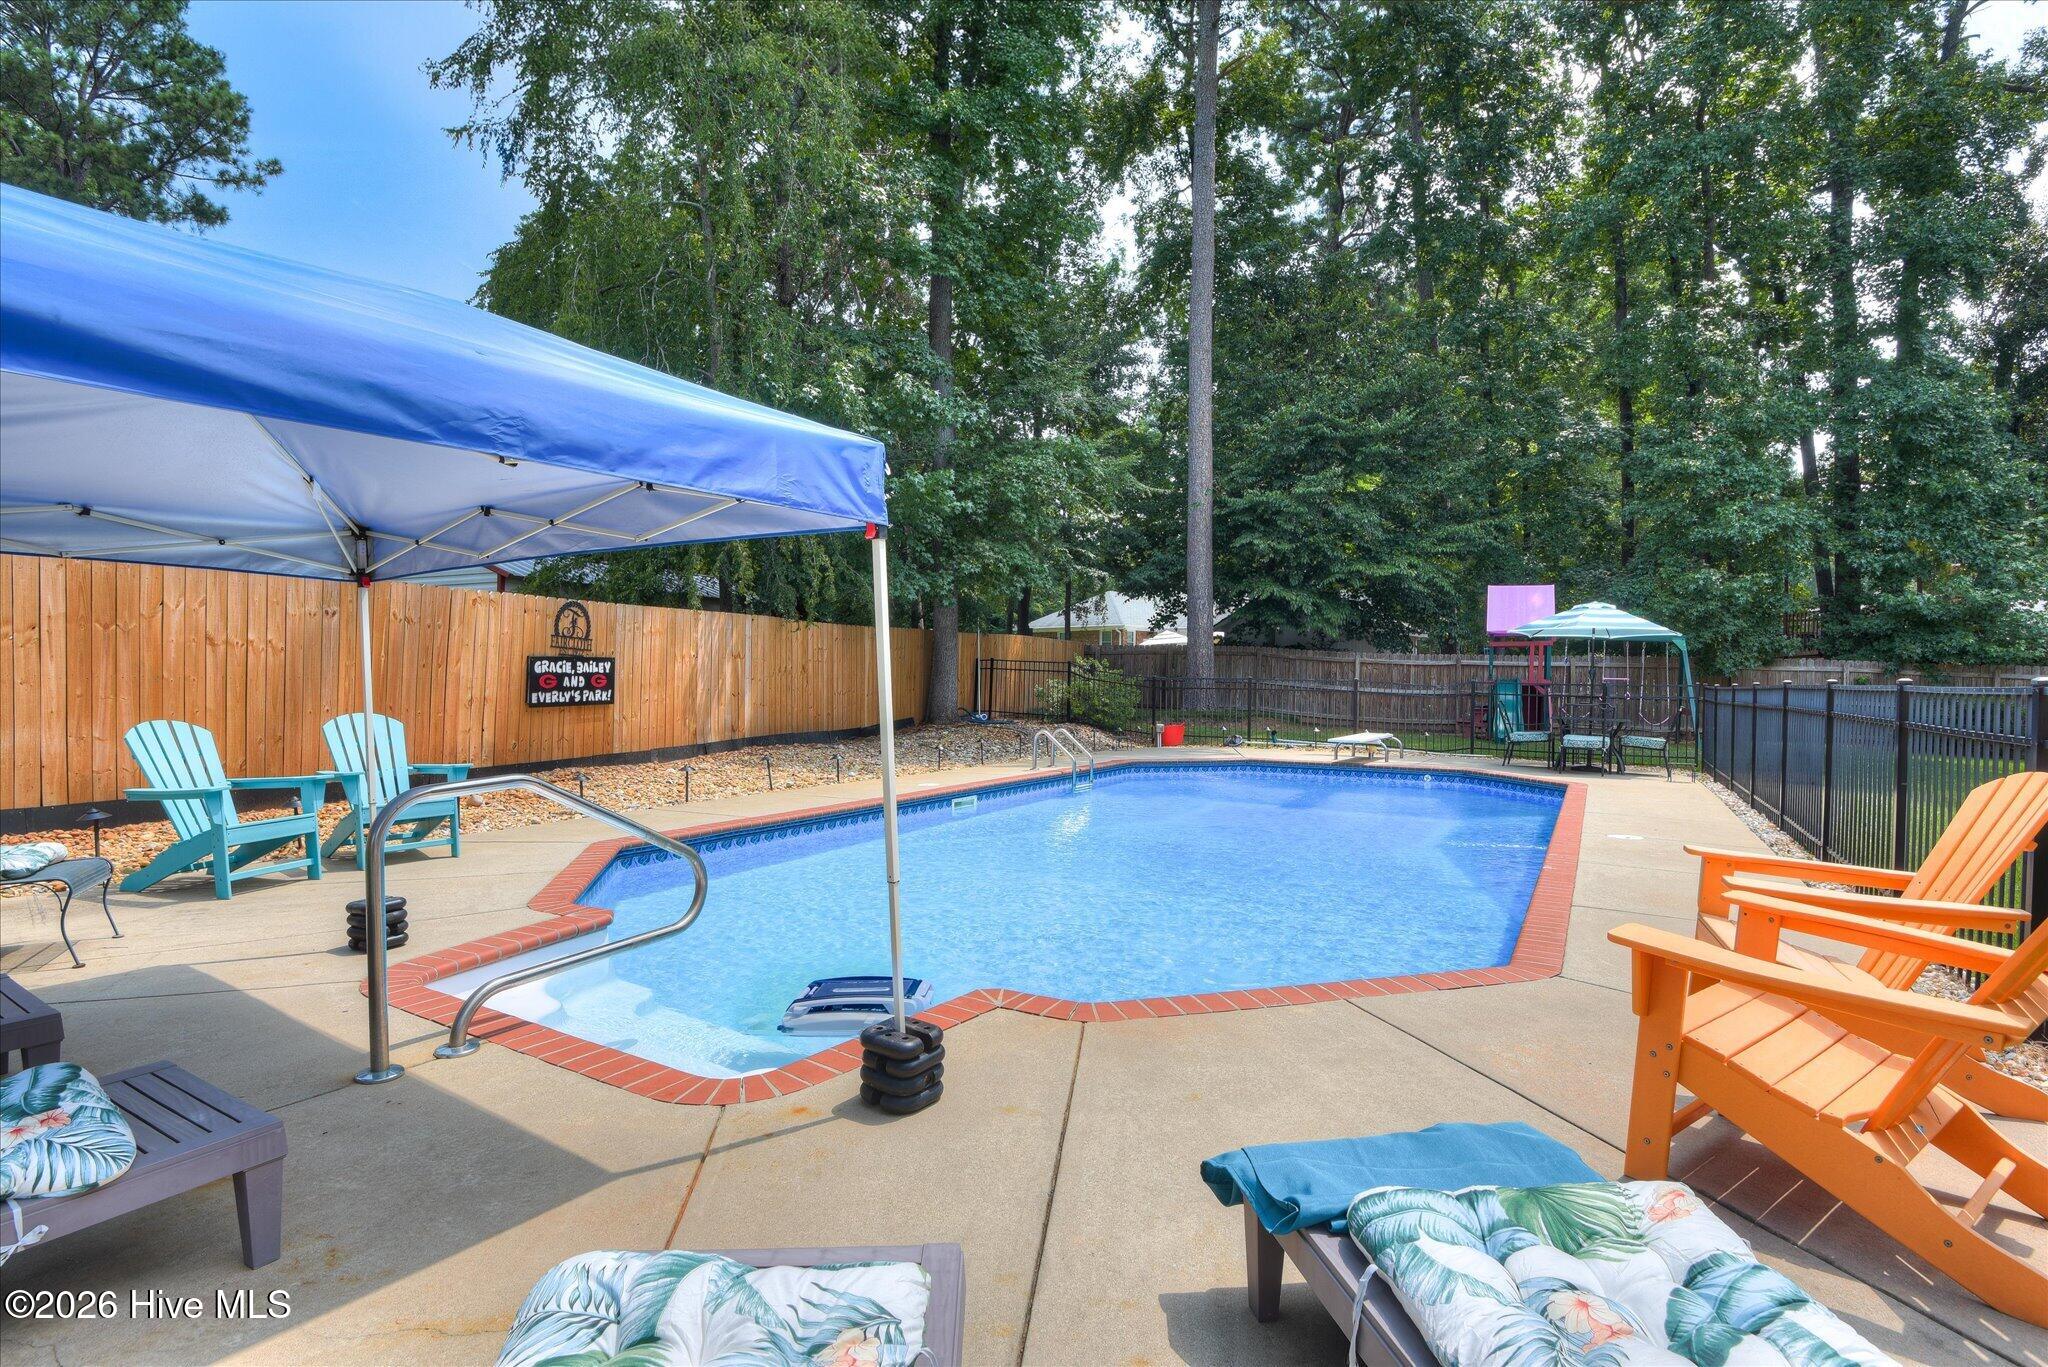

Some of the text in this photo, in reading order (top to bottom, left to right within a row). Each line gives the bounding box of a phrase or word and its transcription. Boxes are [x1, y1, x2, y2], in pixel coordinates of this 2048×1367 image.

[563, 676, 585, 687] AND
[531, 689, 612, 703] EVERLY'S PARK!
